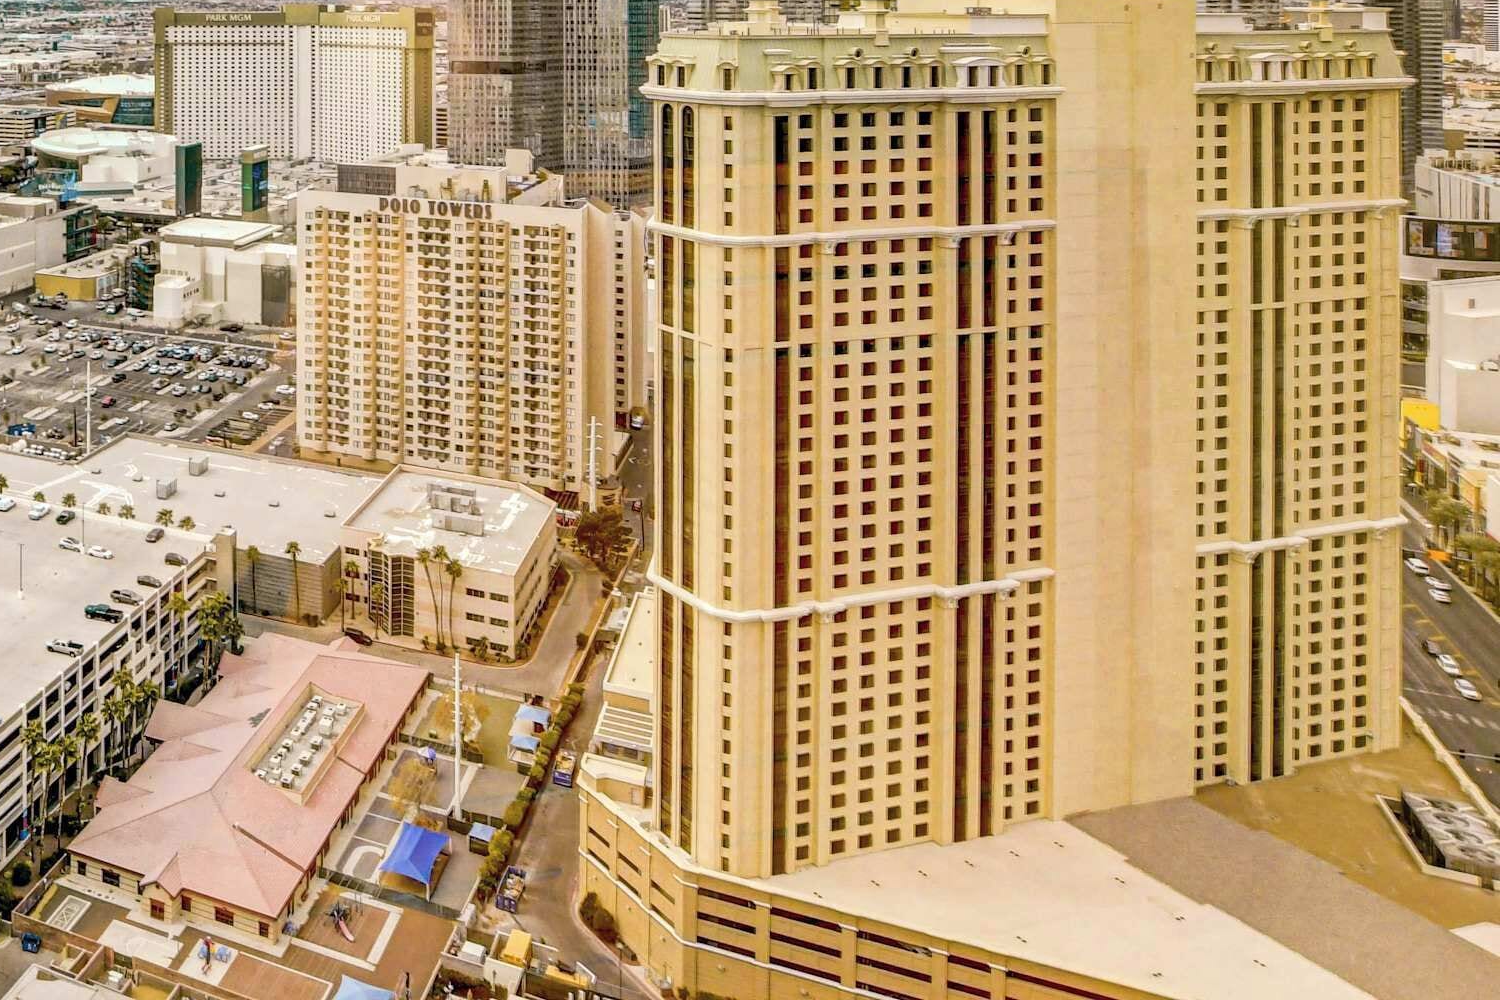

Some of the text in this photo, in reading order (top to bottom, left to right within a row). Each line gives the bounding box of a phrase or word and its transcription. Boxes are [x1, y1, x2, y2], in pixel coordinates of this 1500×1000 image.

[205, 13, 252, 22] PARK MGM
[380, 197, 492, 219] POLO TOWERS
